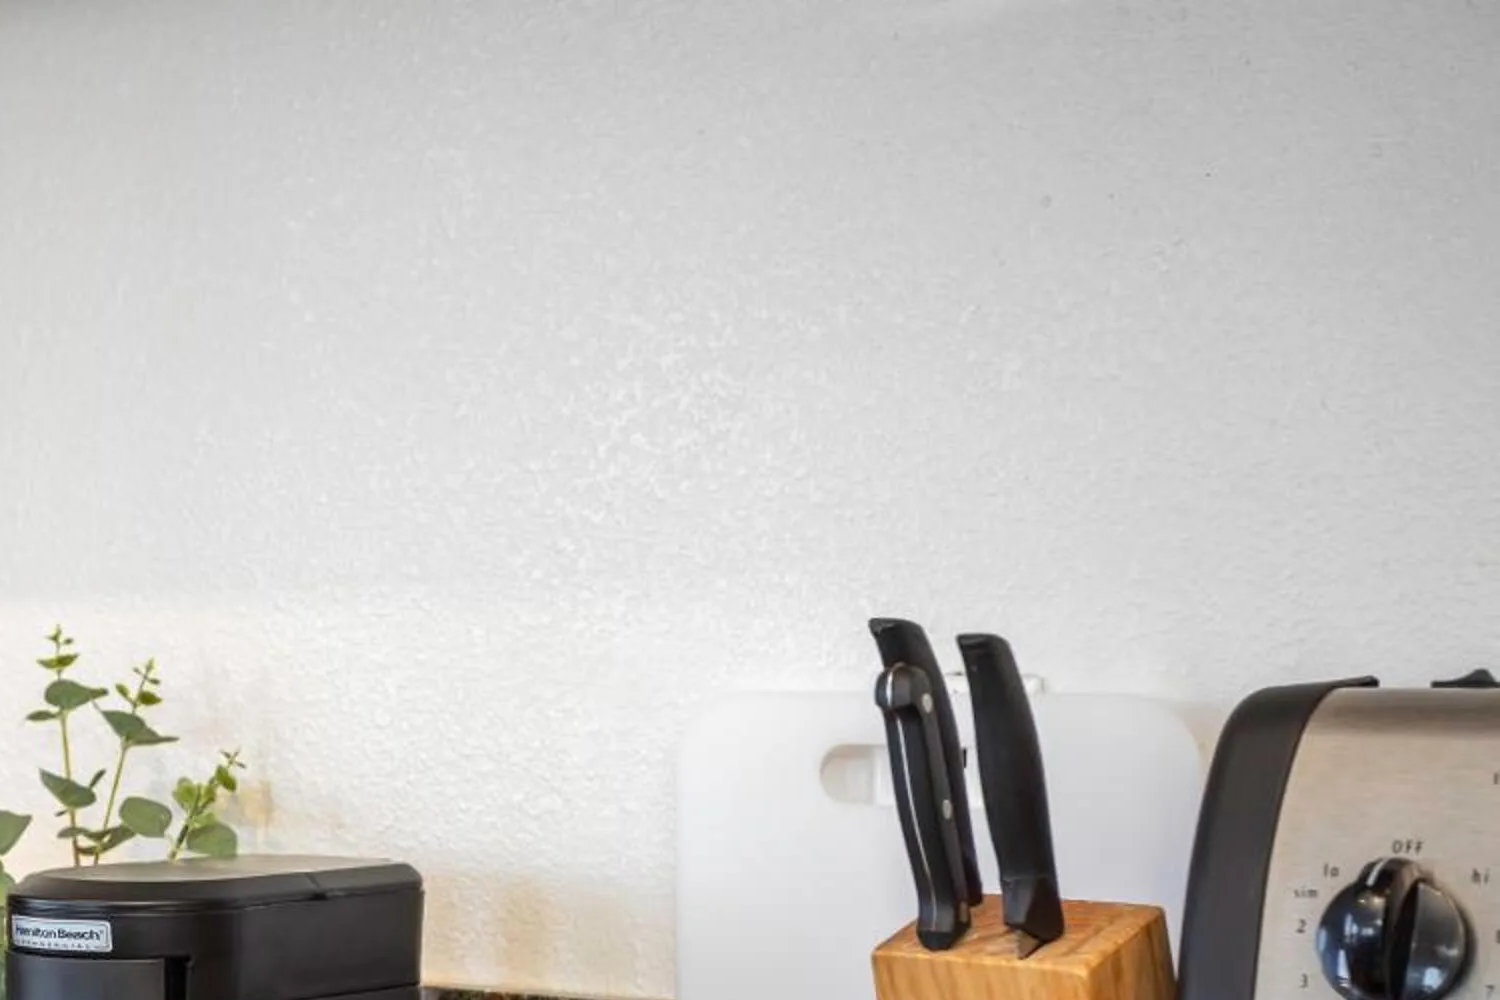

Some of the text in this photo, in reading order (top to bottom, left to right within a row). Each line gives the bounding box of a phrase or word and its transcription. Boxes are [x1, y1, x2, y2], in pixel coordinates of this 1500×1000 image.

[1392, 839, 1424, 854] OFF
[1296, 919, 1307, 934] 2
[1299, 973, 1309, 989] 3
